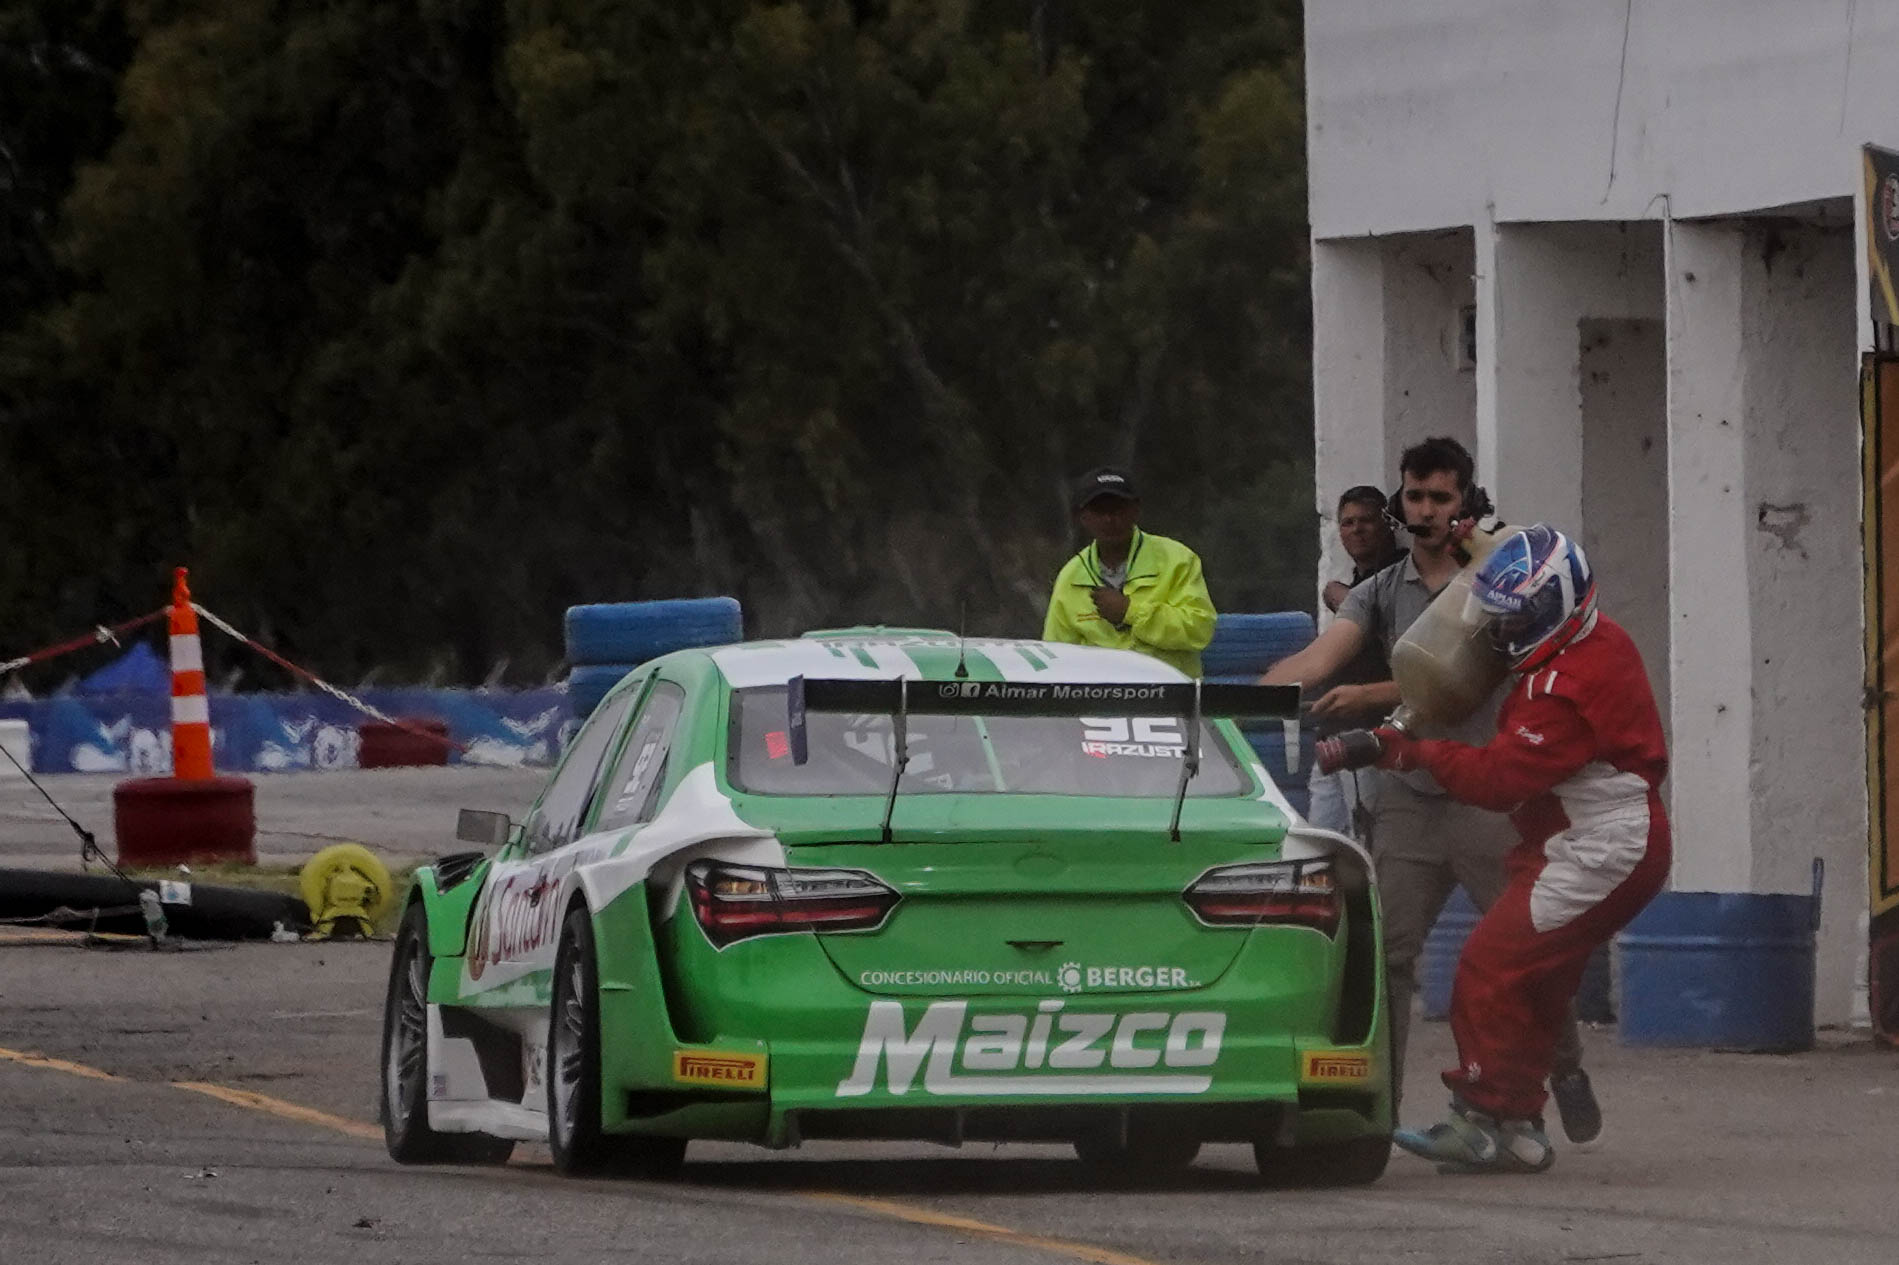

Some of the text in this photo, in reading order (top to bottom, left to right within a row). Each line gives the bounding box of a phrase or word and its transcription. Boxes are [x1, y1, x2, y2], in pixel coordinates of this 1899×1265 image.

[1053, 684, 1166, 700] Motorsport
[1081, 741, 1204, 759] IRAZUST
[861, 970, 990, 986] CONCESIONARIO
[993, 970, 1053, 986] OFICIAL
[1087, 966, 1191, 988] BERGER
[835, 999, 1227, 1098] Maizco
[680, 1056, 756, 1081] PIRELLI
